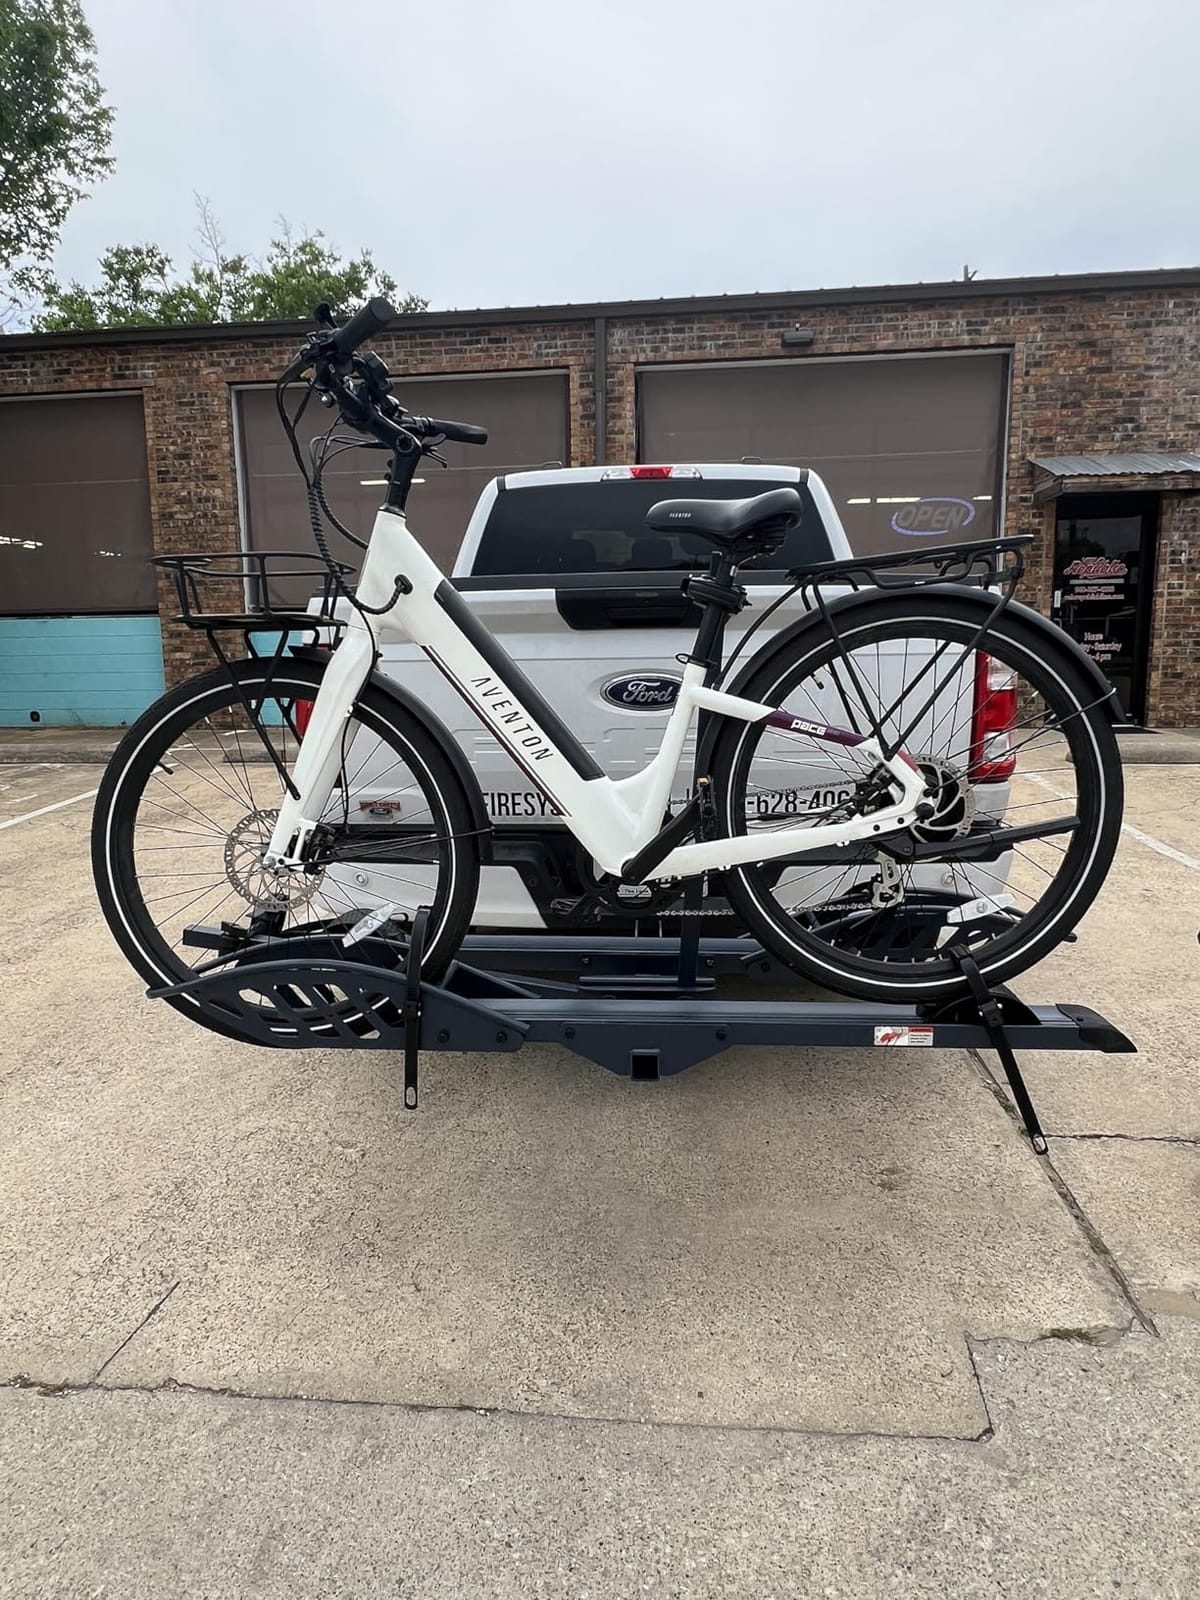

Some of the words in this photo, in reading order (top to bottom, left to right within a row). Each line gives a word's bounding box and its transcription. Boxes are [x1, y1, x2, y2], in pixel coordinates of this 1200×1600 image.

[897, 505, 964, 529] OPEN
[622, 681, 673, 702] Ford
[470, 676, 554, 761] AVENTON
[482, 792, 560, 816] IRESY
